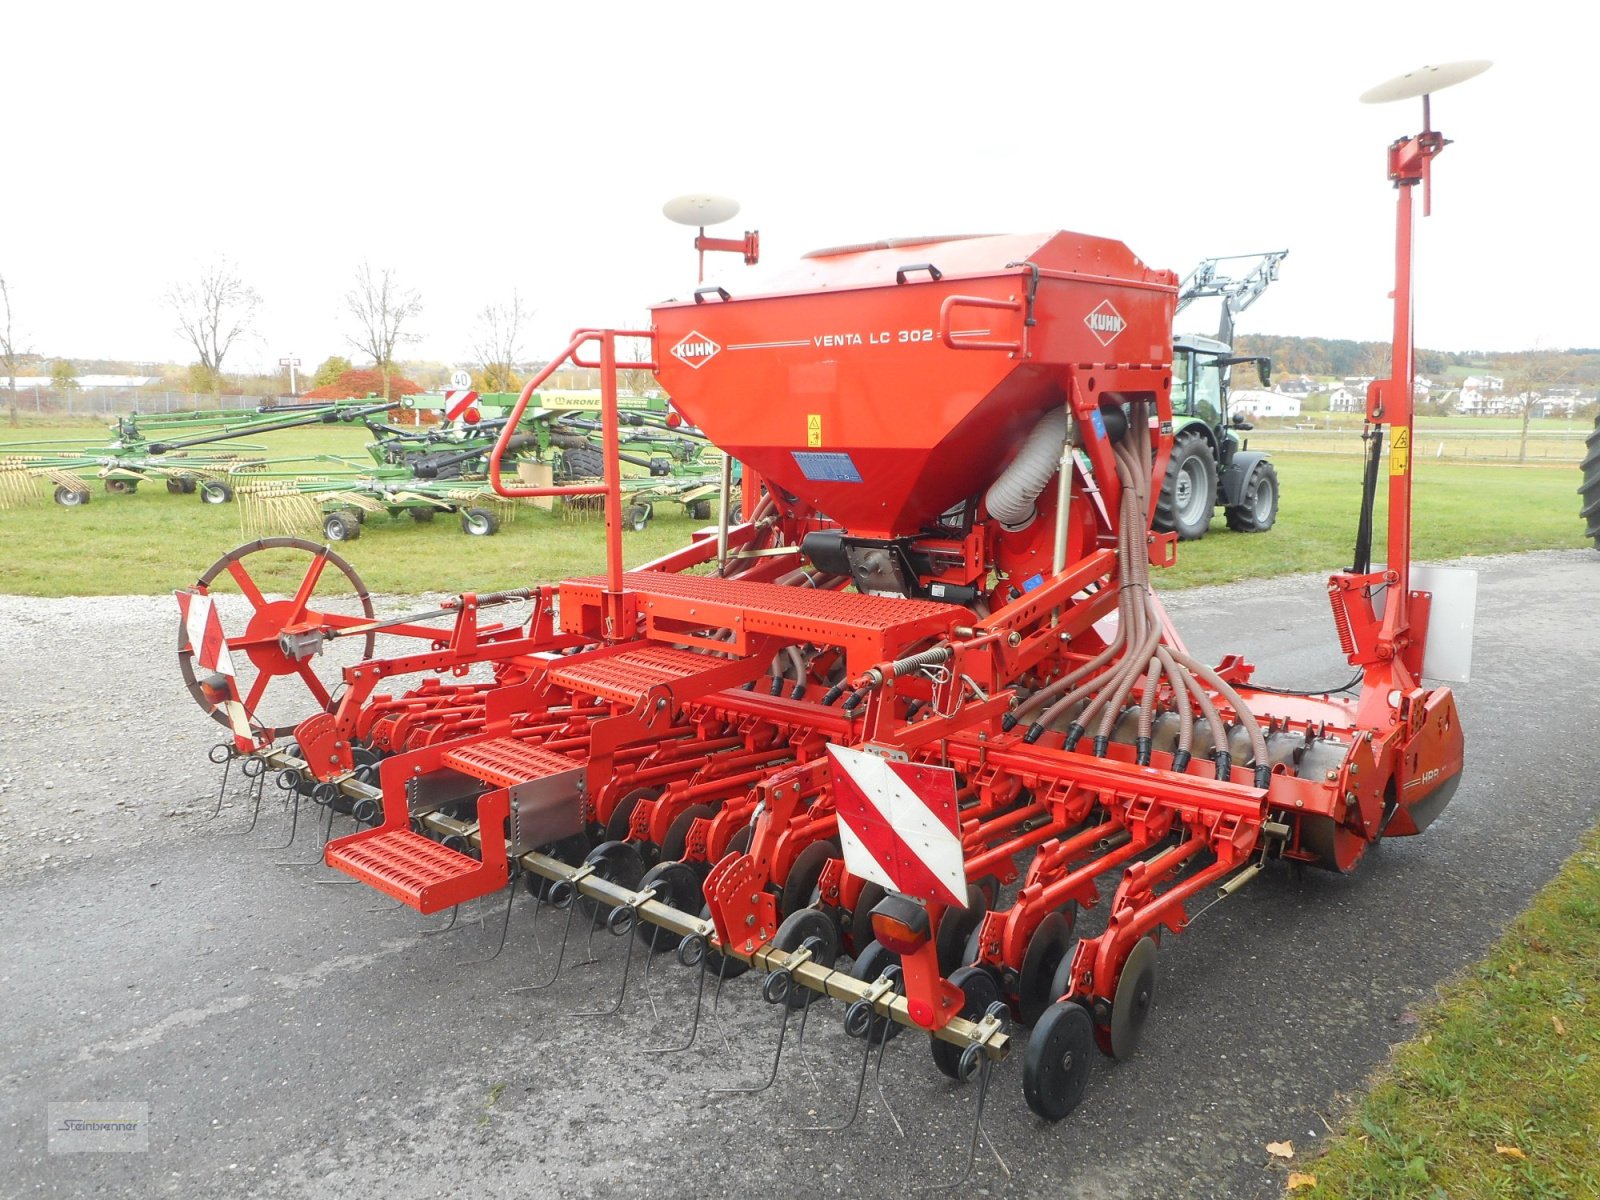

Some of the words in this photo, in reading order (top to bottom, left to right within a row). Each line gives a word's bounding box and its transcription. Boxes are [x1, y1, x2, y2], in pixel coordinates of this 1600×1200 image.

[1090, 313, 1121, 332] KUHN
[813, 333, 862, 348] VENTA
[869, 332, 890, 345] LC
[898, 329, 933, 343] 302
[676, 342, 714, 357] KUHN
[454, 374, 468, 386] 40
[566, 398, 600, 406] KRONE
